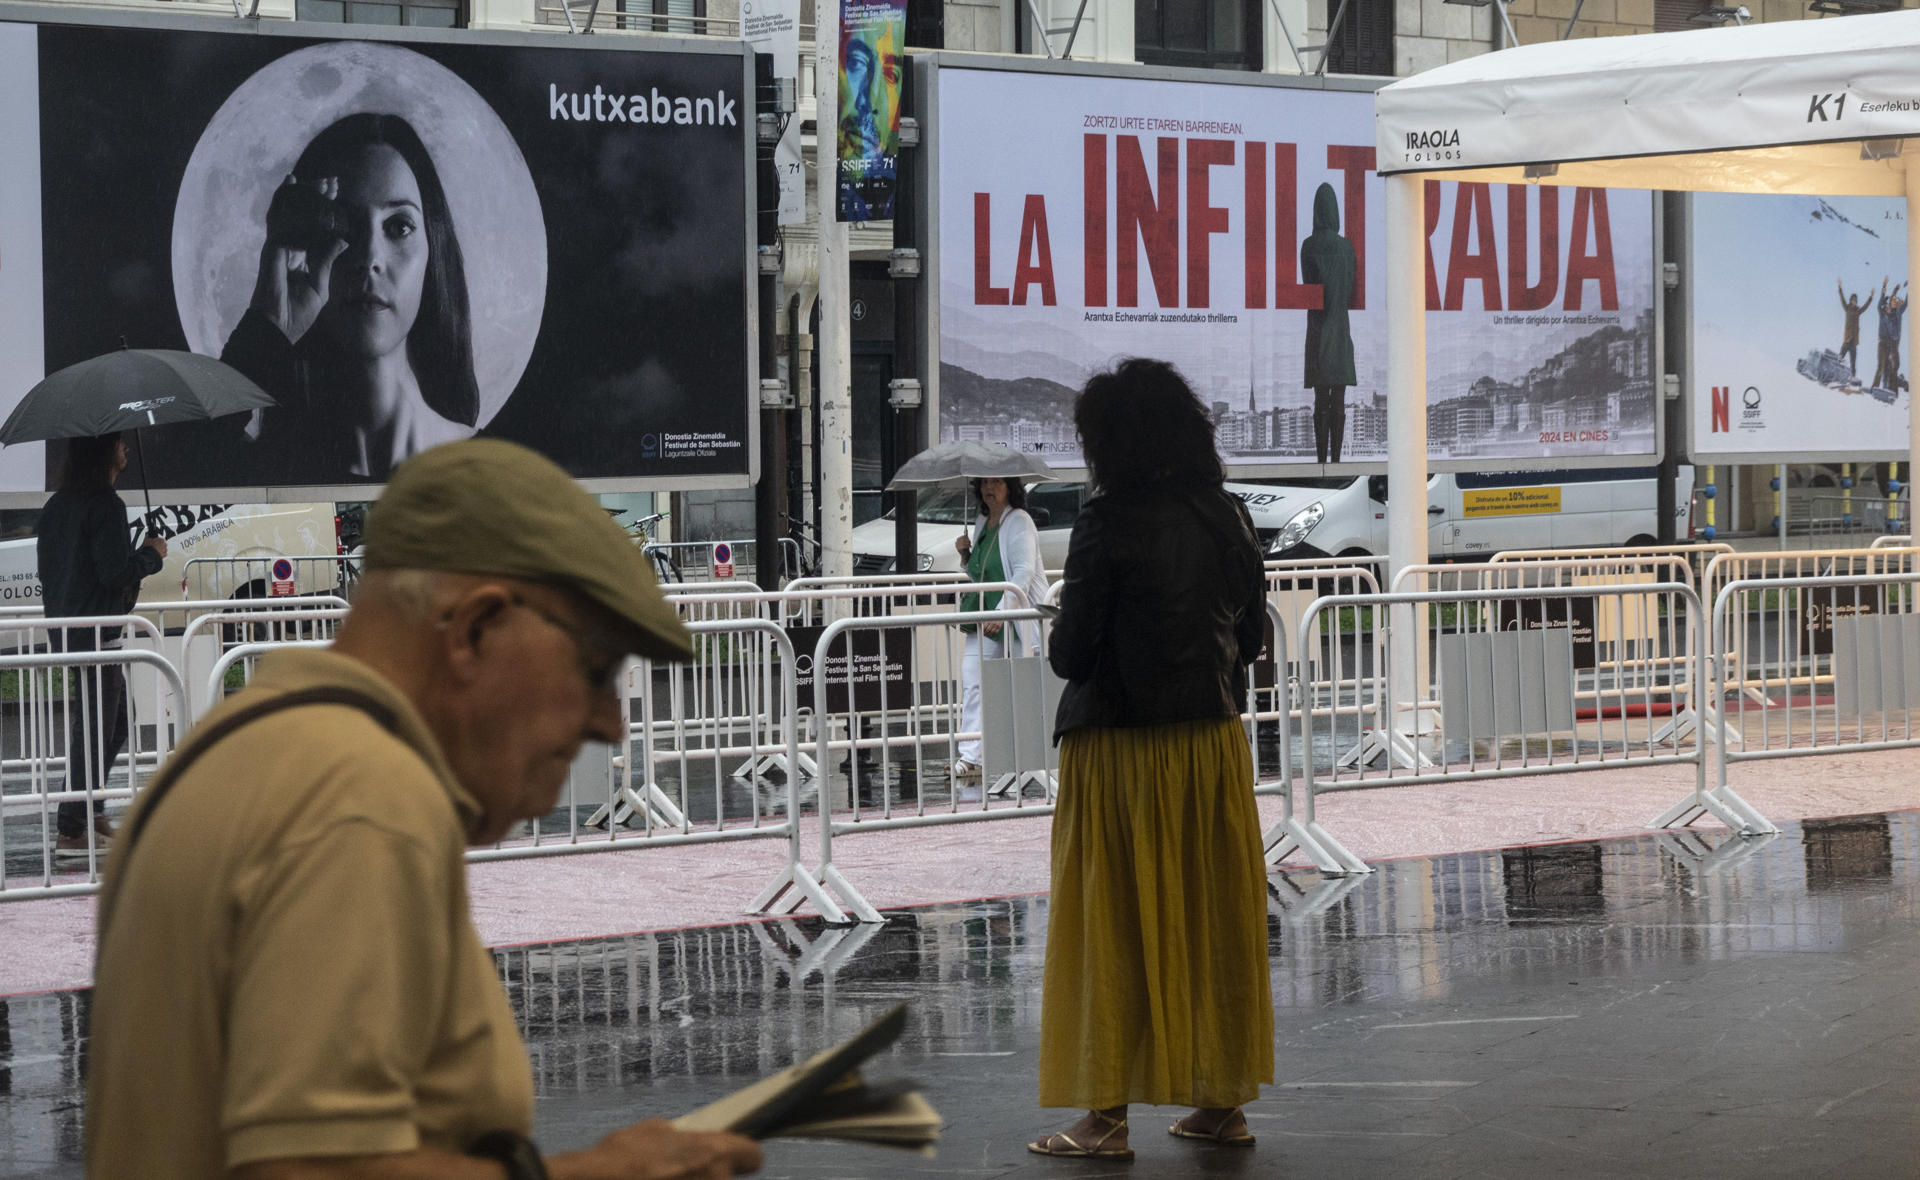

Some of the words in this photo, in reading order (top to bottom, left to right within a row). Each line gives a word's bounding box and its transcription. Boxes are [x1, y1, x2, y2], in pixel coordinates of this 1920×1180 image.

[549, 82, 738, 127] kutxabank
[1807, 92, 1847, 123] K1
[1859, 100, 1910, 112] Eserleku
[1083, 115, 1118, 128] ZORTZI
[1119, 117, 1145, 130] URTE
[1147, 118, 1184, 131] ETAREN
[1185, 120, 1244, 135] BARRENEAN.
[1406, 128, 1460, 150] IRAOLA
[1405, 150, 1461, 163] TOLDOS
[788, 163, 800, 174] 71
[974, 192, 1057, 306] LA
[853, 302, 862, 317] 4
[1084, 312, 1114, 322] Arantxa
[1160, 313, 1206, 323] zuzendutako
[1207, 313, 1238, 323] thrillerra
[1493, 315, 1503, 325] Un
[1504, 315, 1525, 325] thriller
[1526, 315, 1550, 327] dirigido
[1551, 316, 1561, 327] por
[1562, 315, 1587, 325] Arantxa
[1711, 386, 1729, 433] N
[1742, 410, 1762, 419] SSIFF
[664, 433, 692, 441] Donostia
[692, 432, 727, 440] Zinemaldia
[1539, 431, 1561, 443] 2024
[1563, 431, 1577, 442] EN
[1579, 430, 1609, 442] CINES
[689, 441, 698, 449] de
[698, 440, 710, 448] San
[711, 440, 741, 448] Sebastián
[1022, 442, 1076, 453] BOWFINGER
[1509, 491, 1525, 501] 10%
[181, 534, 202, 550] 100%
[202, 518, 235, 540] ARÁBICA
[12, 573, 24, 581] 943
[25, 572, 33, 580] 65
[0, 585, 42, 600] OLOS
[859, 664, 872, 673] San
[865, 673, 878, 682] Film
